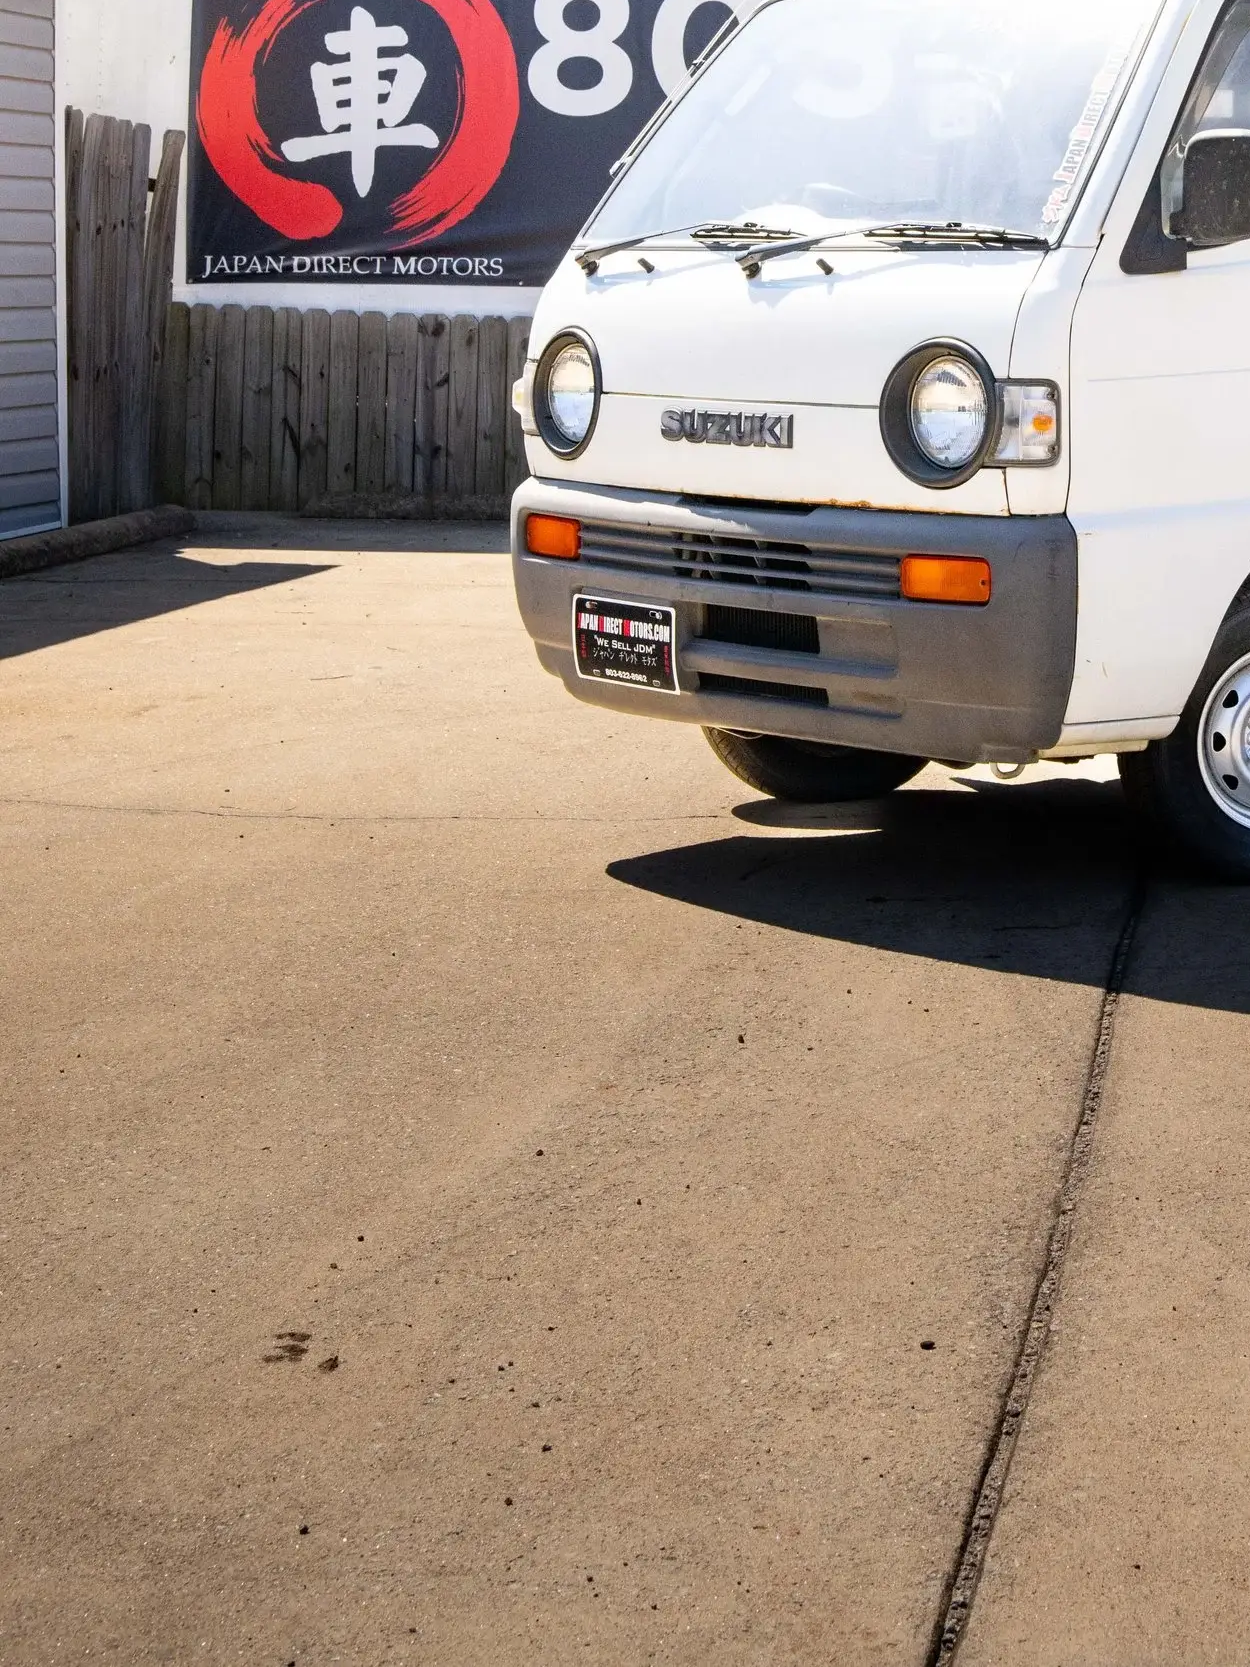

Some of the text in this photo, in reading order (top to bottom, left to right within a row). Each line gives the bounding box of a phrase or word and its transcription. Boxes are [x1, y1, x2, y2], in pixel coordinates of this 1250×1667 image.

[280, 6, 439, 199] 車
[202, 255, 504, 278] JAPAN DIRECT MOTORS
[660, 406, 793, 449] SUZUKI
